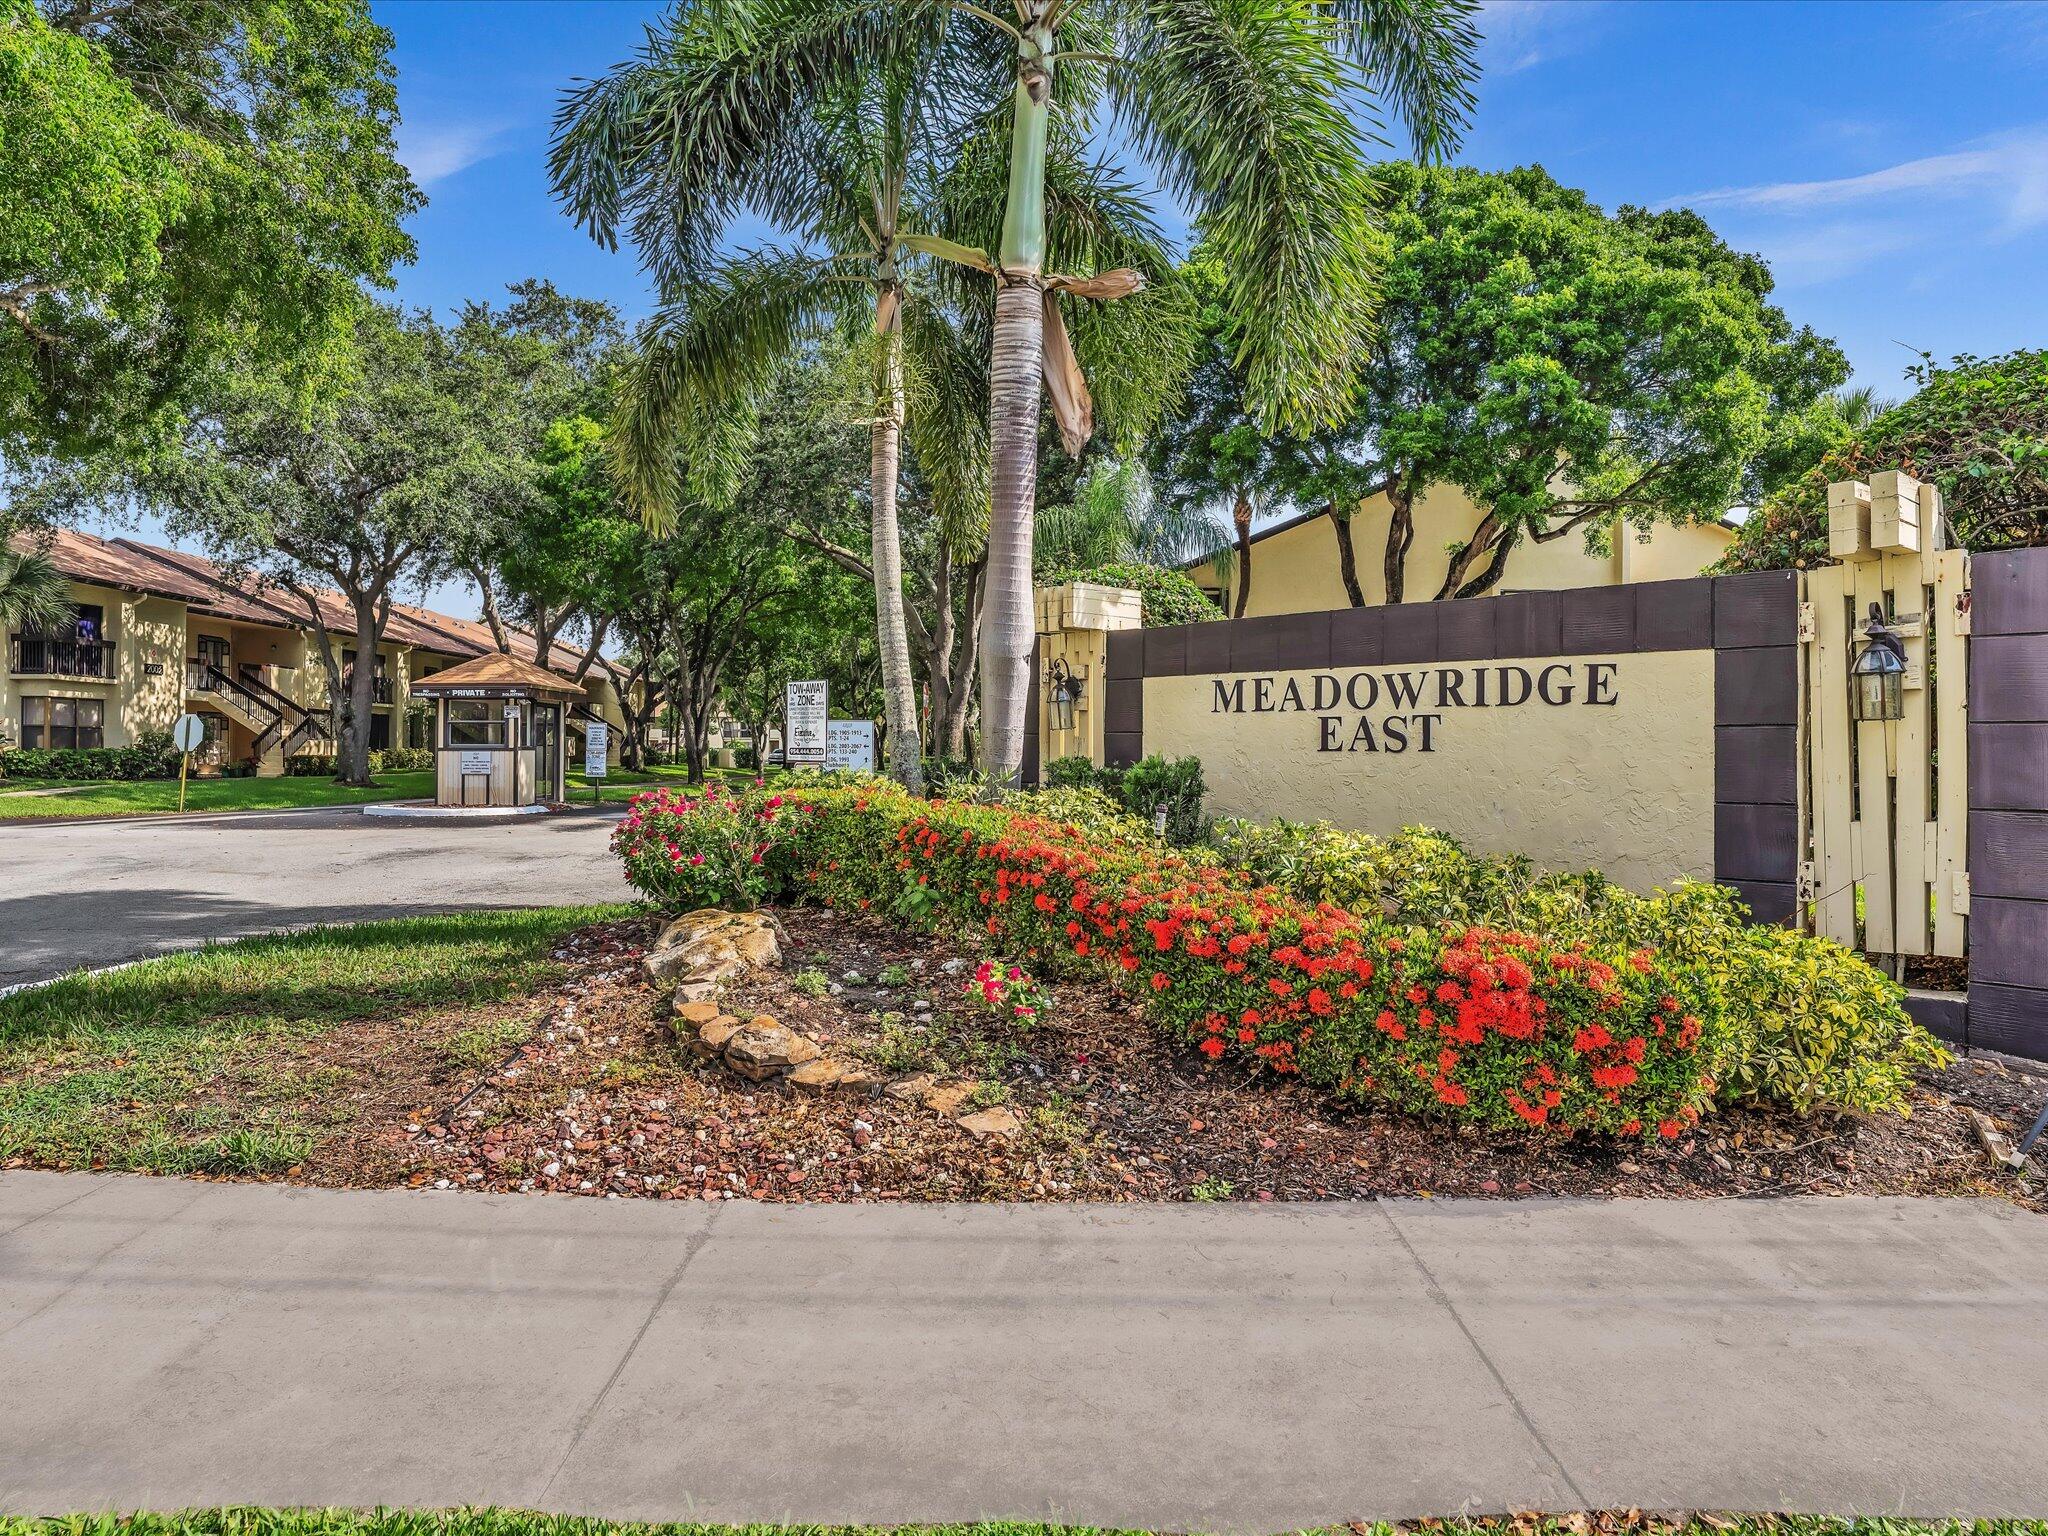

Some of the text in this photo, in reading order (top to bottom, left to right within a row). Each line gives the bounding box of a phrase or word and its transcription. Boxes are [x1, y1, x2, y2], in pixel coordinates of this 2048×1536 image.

[452, 689, 485, 697] PRIVATE
[789, 683, 824, 694] TOW-AWAY
[1211, 663, 1619, 713] MEADOWRIDGE
[798, 695, 815, 705] ZONE
[1316, 714, 1442, 753] EAST
